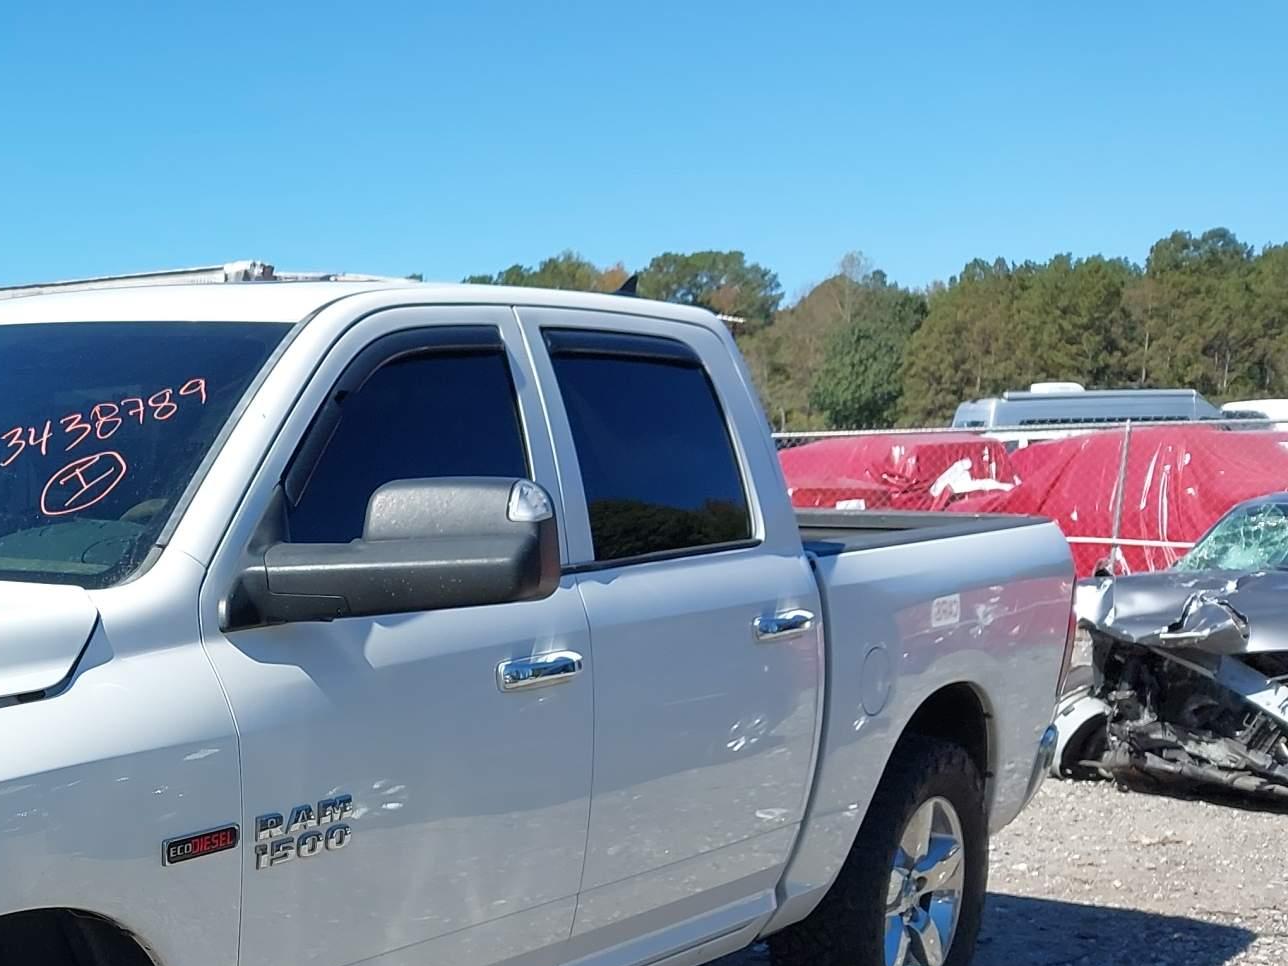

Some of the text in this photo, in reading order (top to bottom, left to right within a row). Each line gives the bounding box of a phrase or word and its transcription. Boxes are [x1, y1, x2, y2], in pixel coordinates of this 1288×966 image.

[254, 794, 353, 842] RAM
[169, 830, 233, 858] ECODIESEL
[254, 823, 353, 870] 1500
